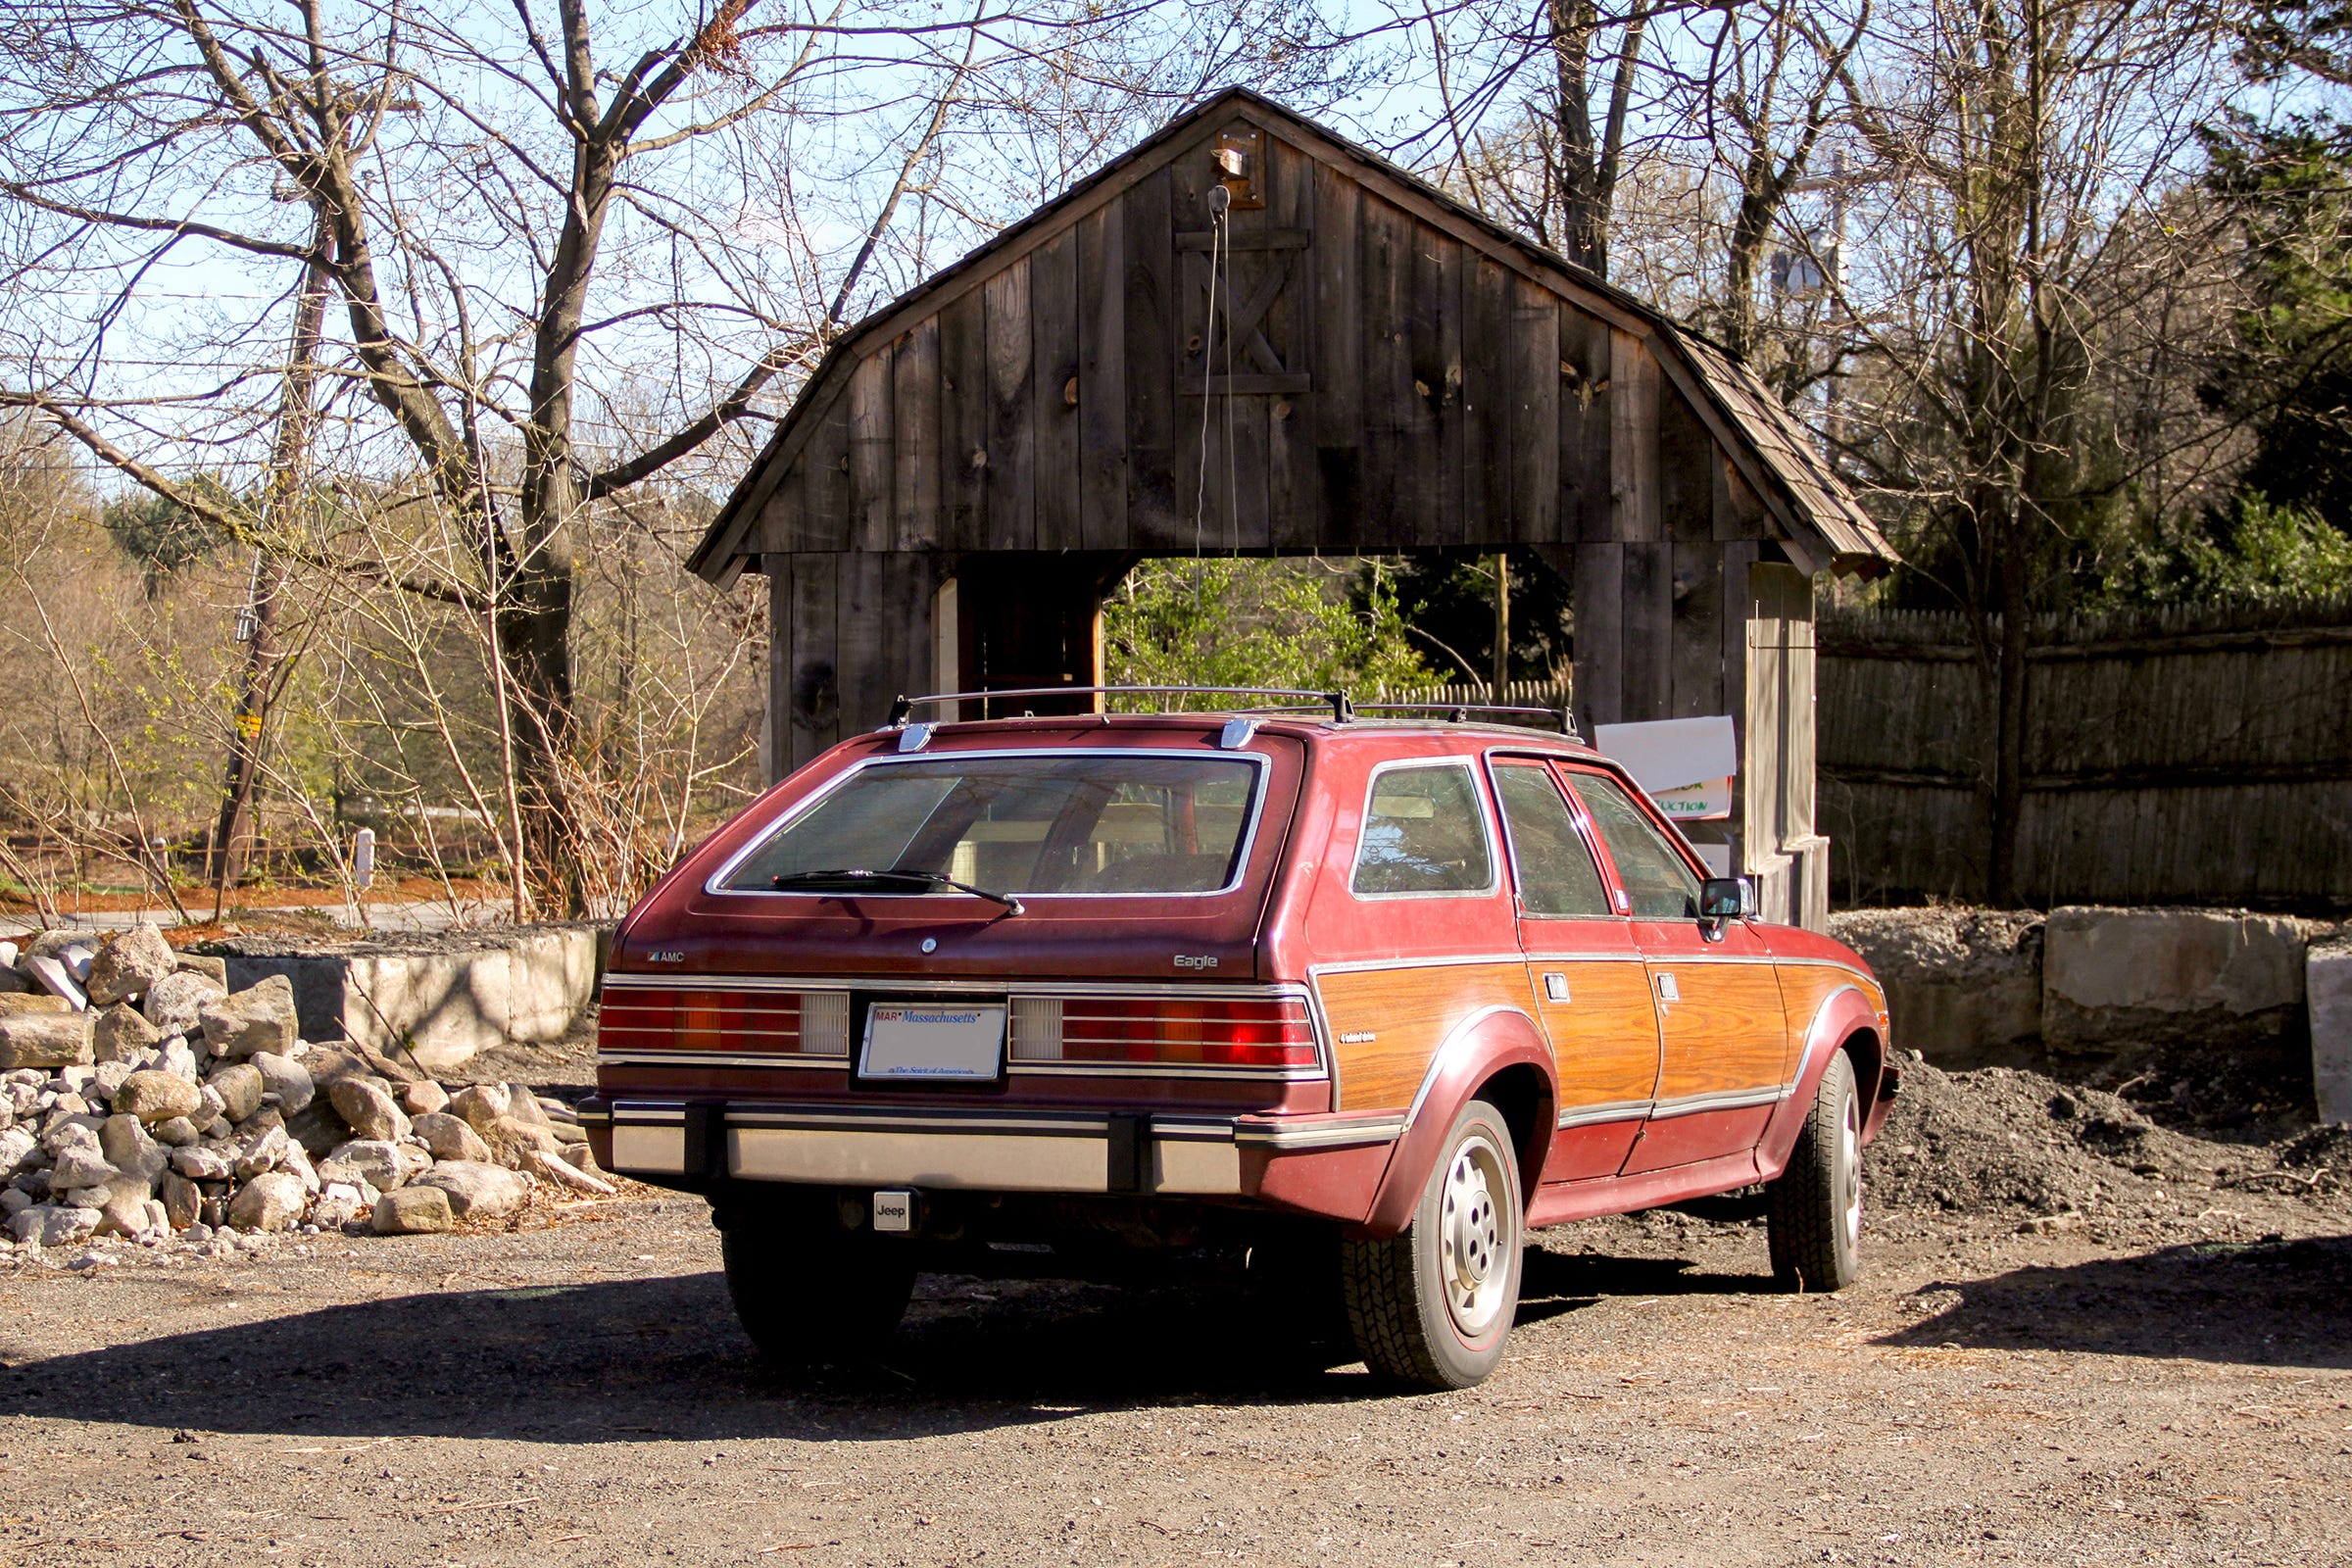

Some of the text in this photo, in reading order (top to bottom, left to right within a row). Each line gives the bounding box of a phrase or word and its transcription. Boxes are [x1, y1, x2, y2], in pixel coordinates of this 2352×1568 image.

[661, 952, 685, 962] AMC
[1174, 955, 1218, 970] Eagle
[876, 1010, 977, 1023] MAR Massachusetts
[877, 1204, 906, 1219] Jeep
